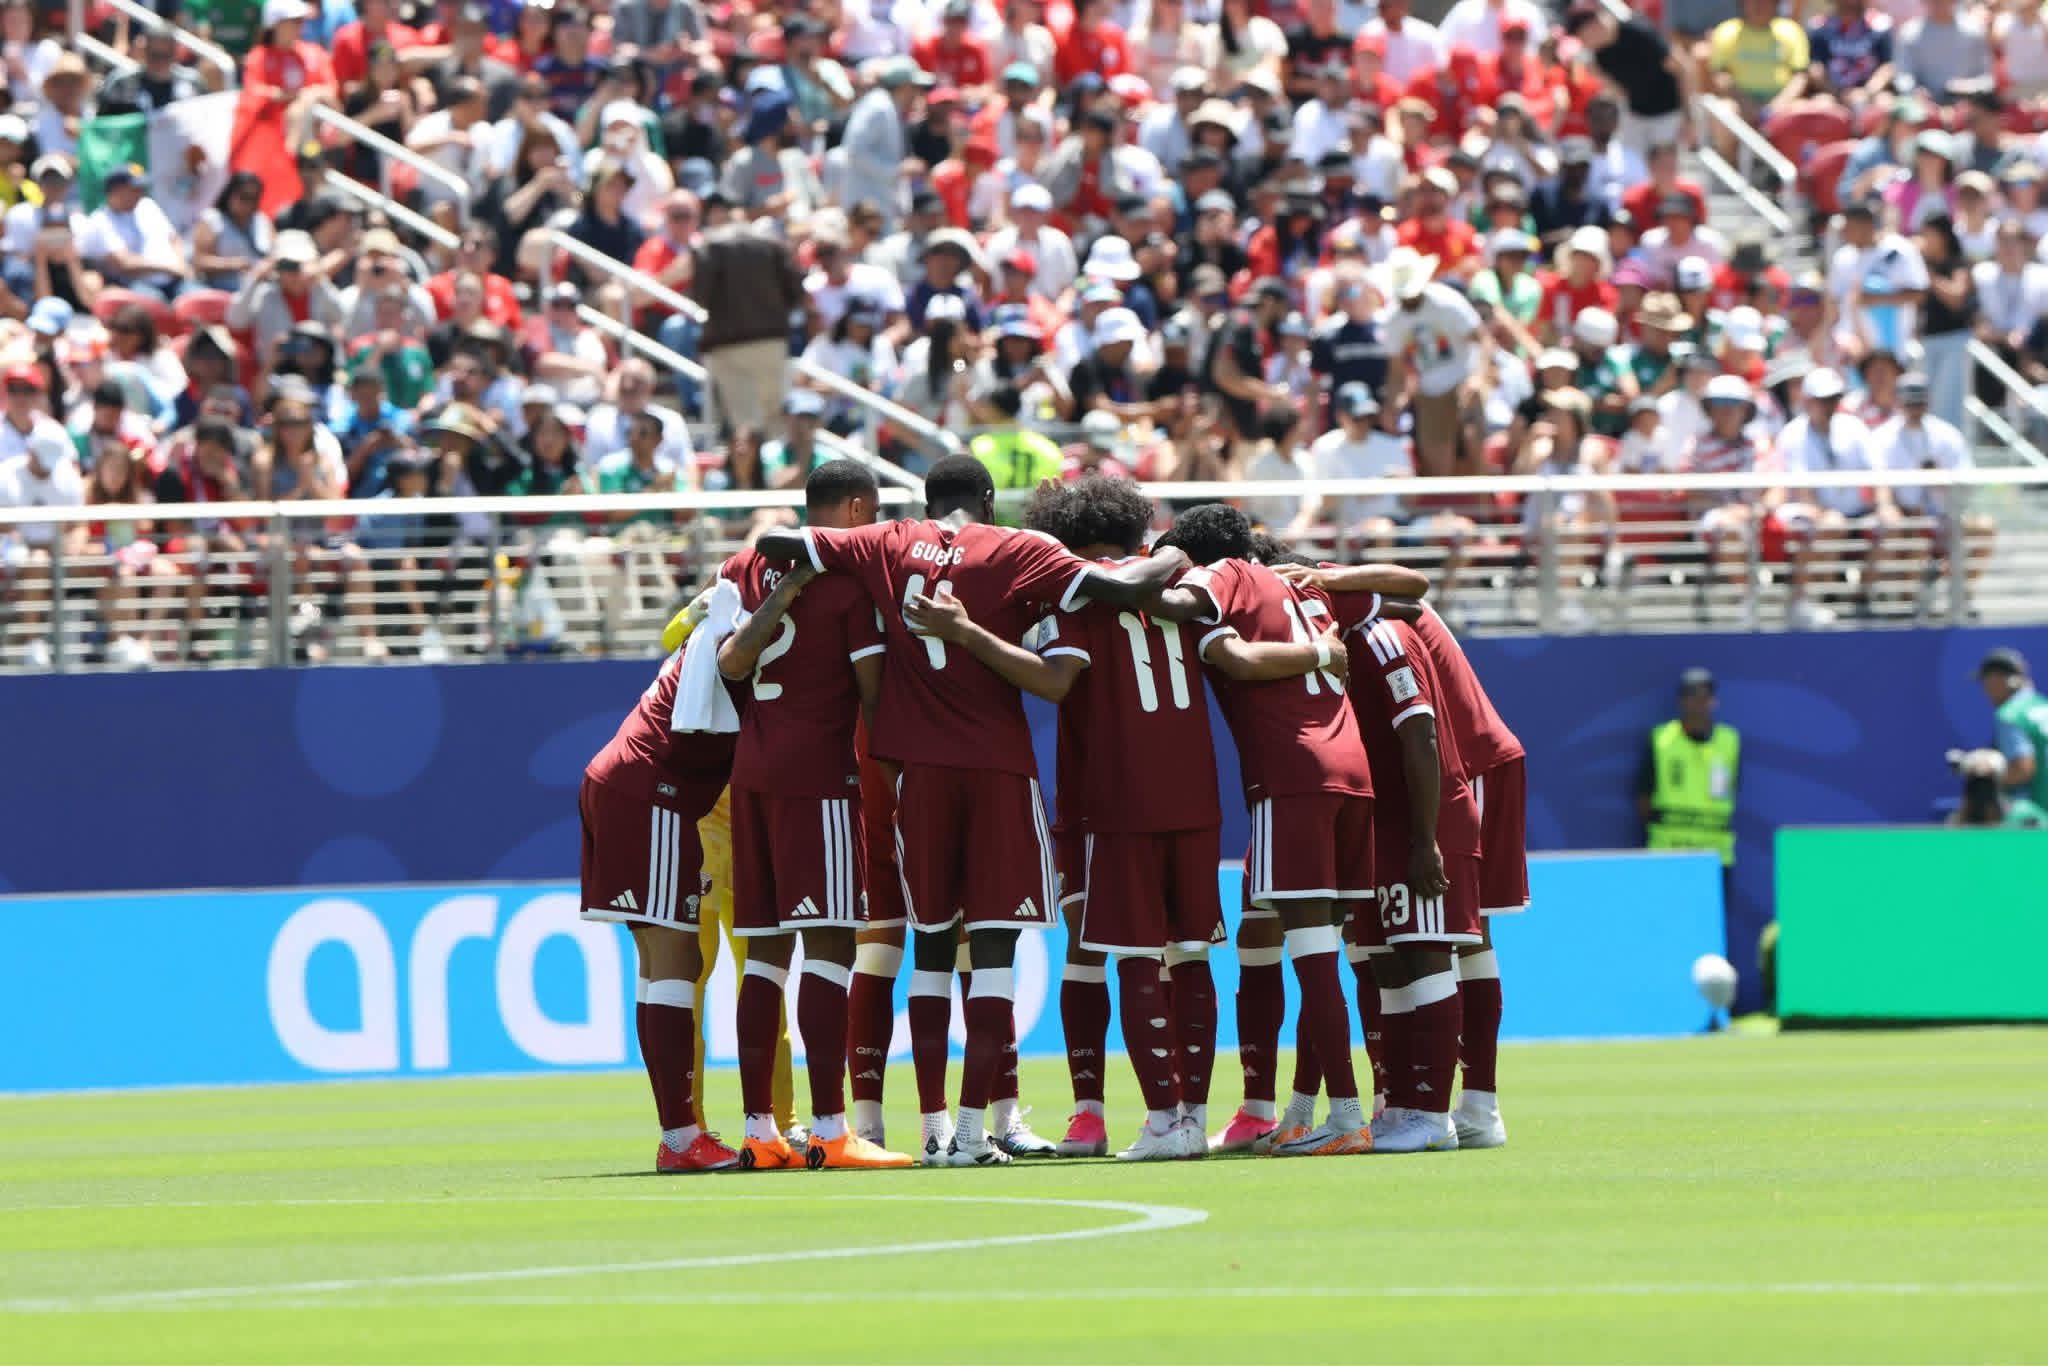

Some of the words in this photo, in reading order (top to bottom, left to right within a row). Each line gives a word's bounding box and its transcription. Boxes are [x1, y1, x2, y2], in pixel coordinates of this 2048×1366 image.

[752, 612, 796, 701] 2
[1119, 611, 1191, 713] 11
[1377, 883, 1410, 928] 23
